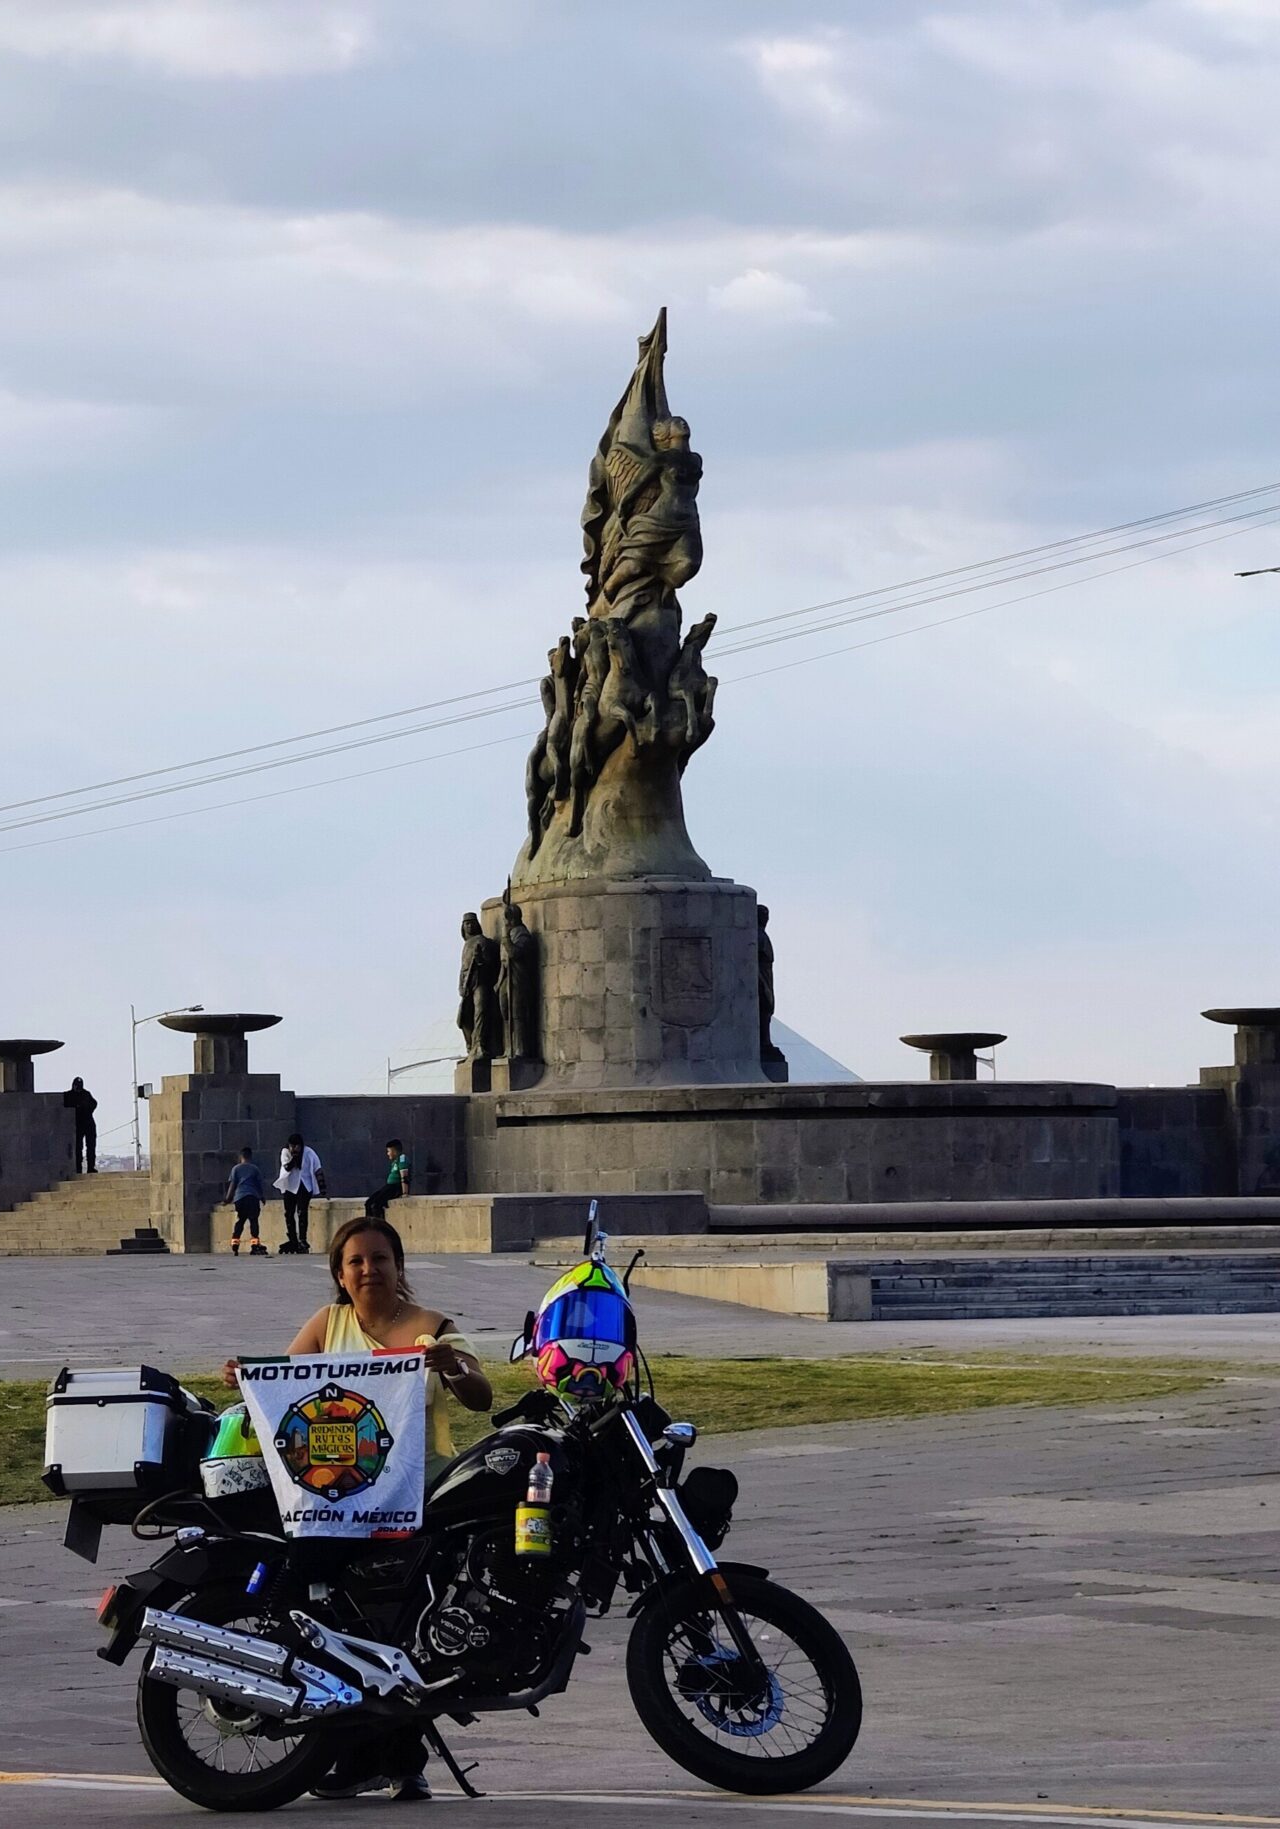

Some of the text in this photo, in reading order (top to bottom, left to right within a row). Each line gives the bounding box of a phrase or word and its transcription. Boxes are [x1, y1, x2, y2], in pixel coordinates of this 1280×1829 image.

[241, 1358, 421, 1381] MOTOTURISMO
[325, 1388, 338, 1398] N
[379, 1437, 390, 1447] E
[327, 1489, 339, 1498] S
[352, 1507, 417, 1523] MÉXICO
[440, 1618, 465, 1635] VENTO
